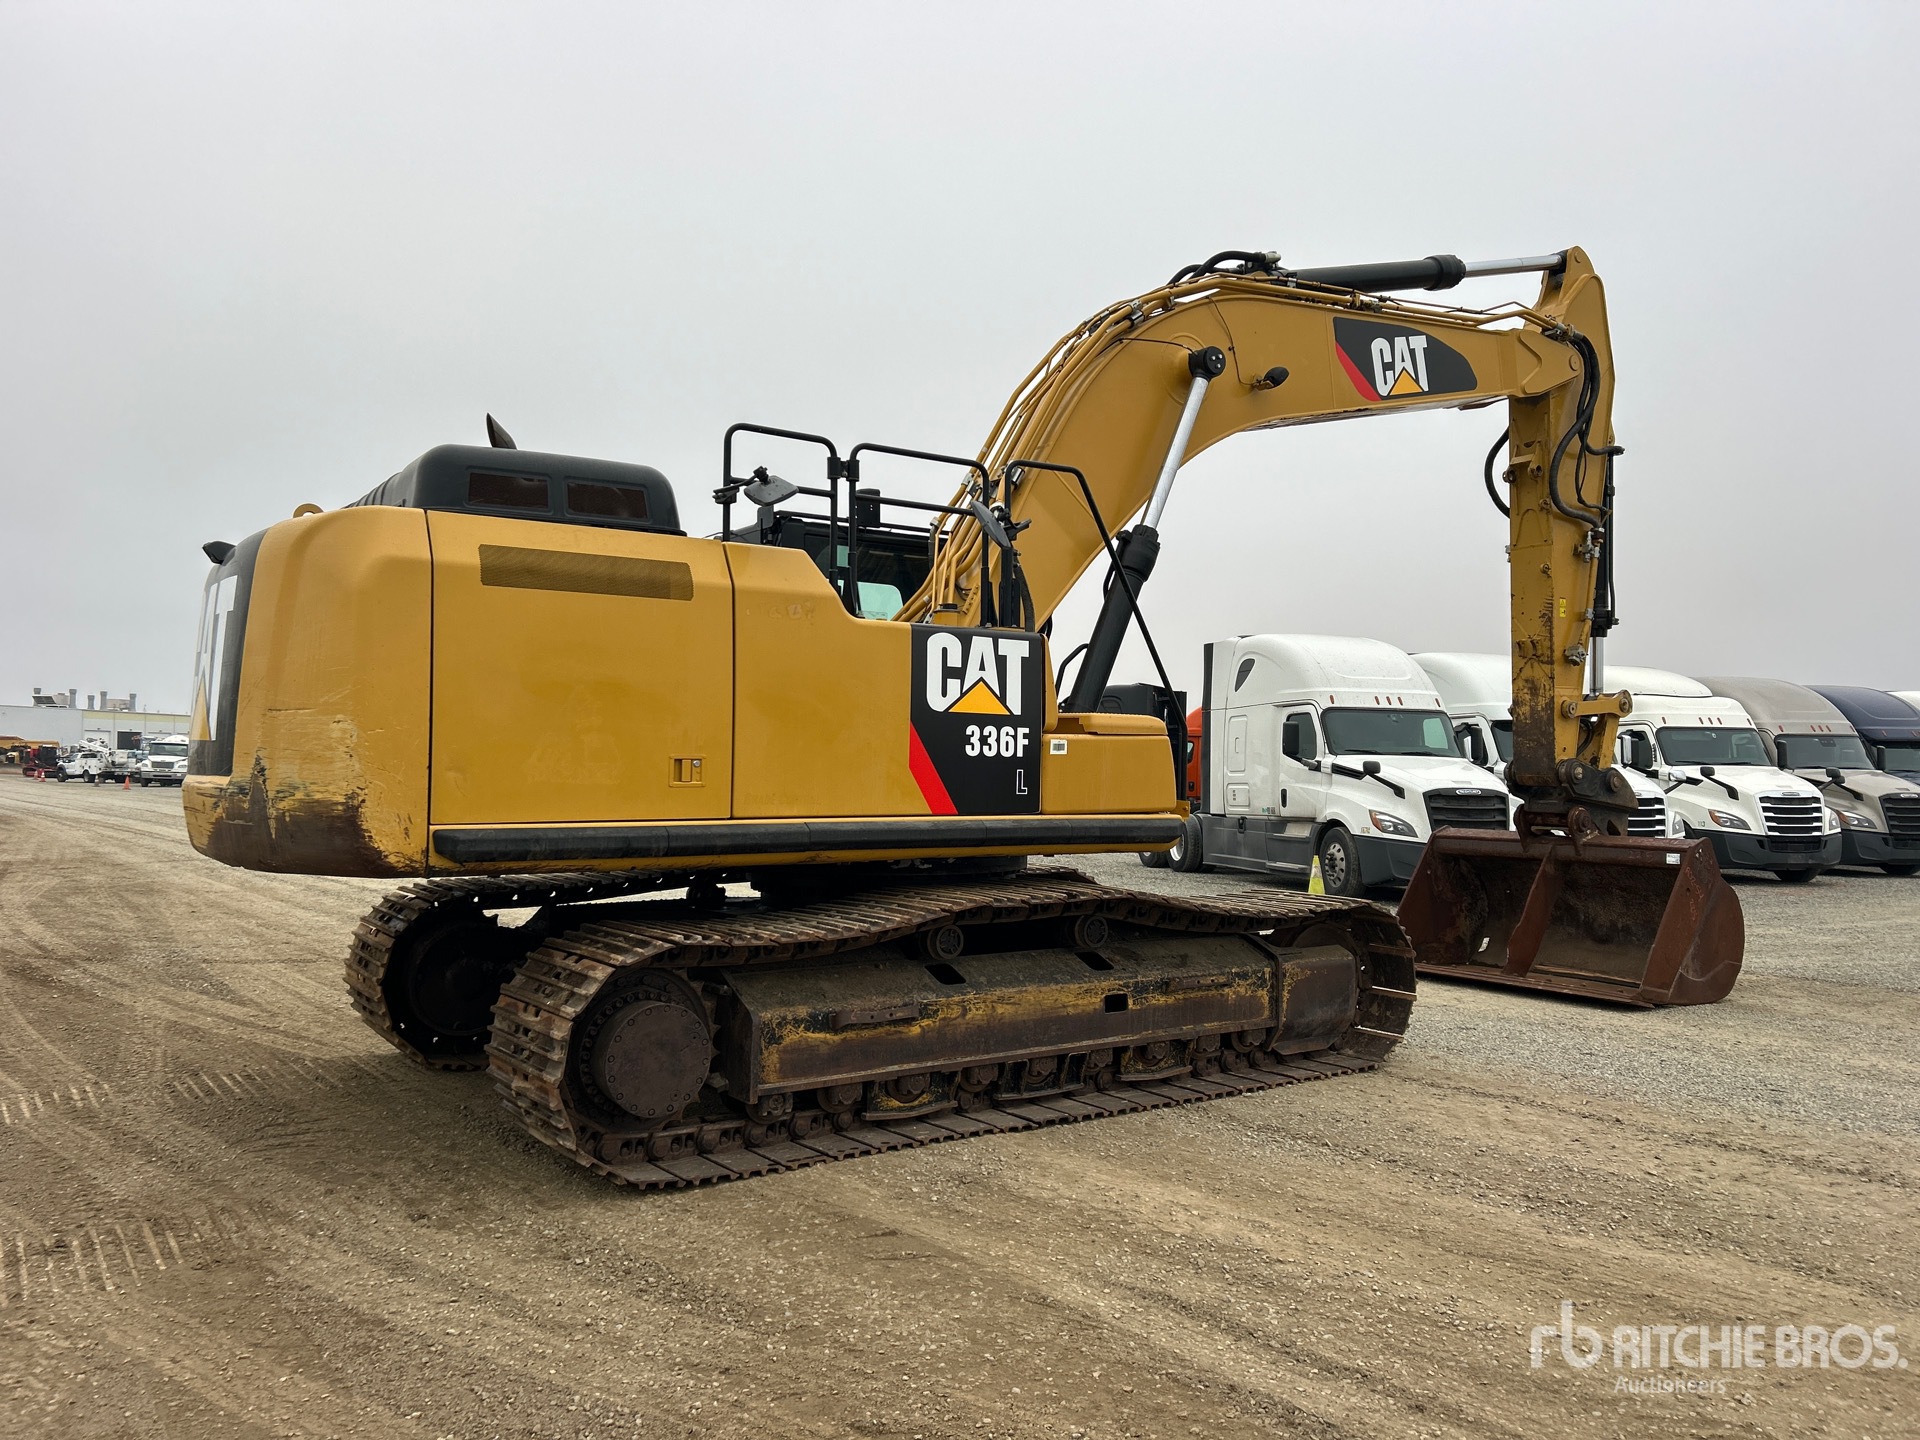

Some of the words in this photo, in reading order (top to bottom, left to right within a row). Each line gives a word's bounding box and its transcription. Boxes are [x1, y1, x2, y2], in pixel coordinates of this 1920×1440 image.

[1370, 334, 1429, 397] CAT
[926, 632, 1030, 716] CAT
[965, 724, 1030, 758] 336F
[1015, 768, 1028, 795] L
